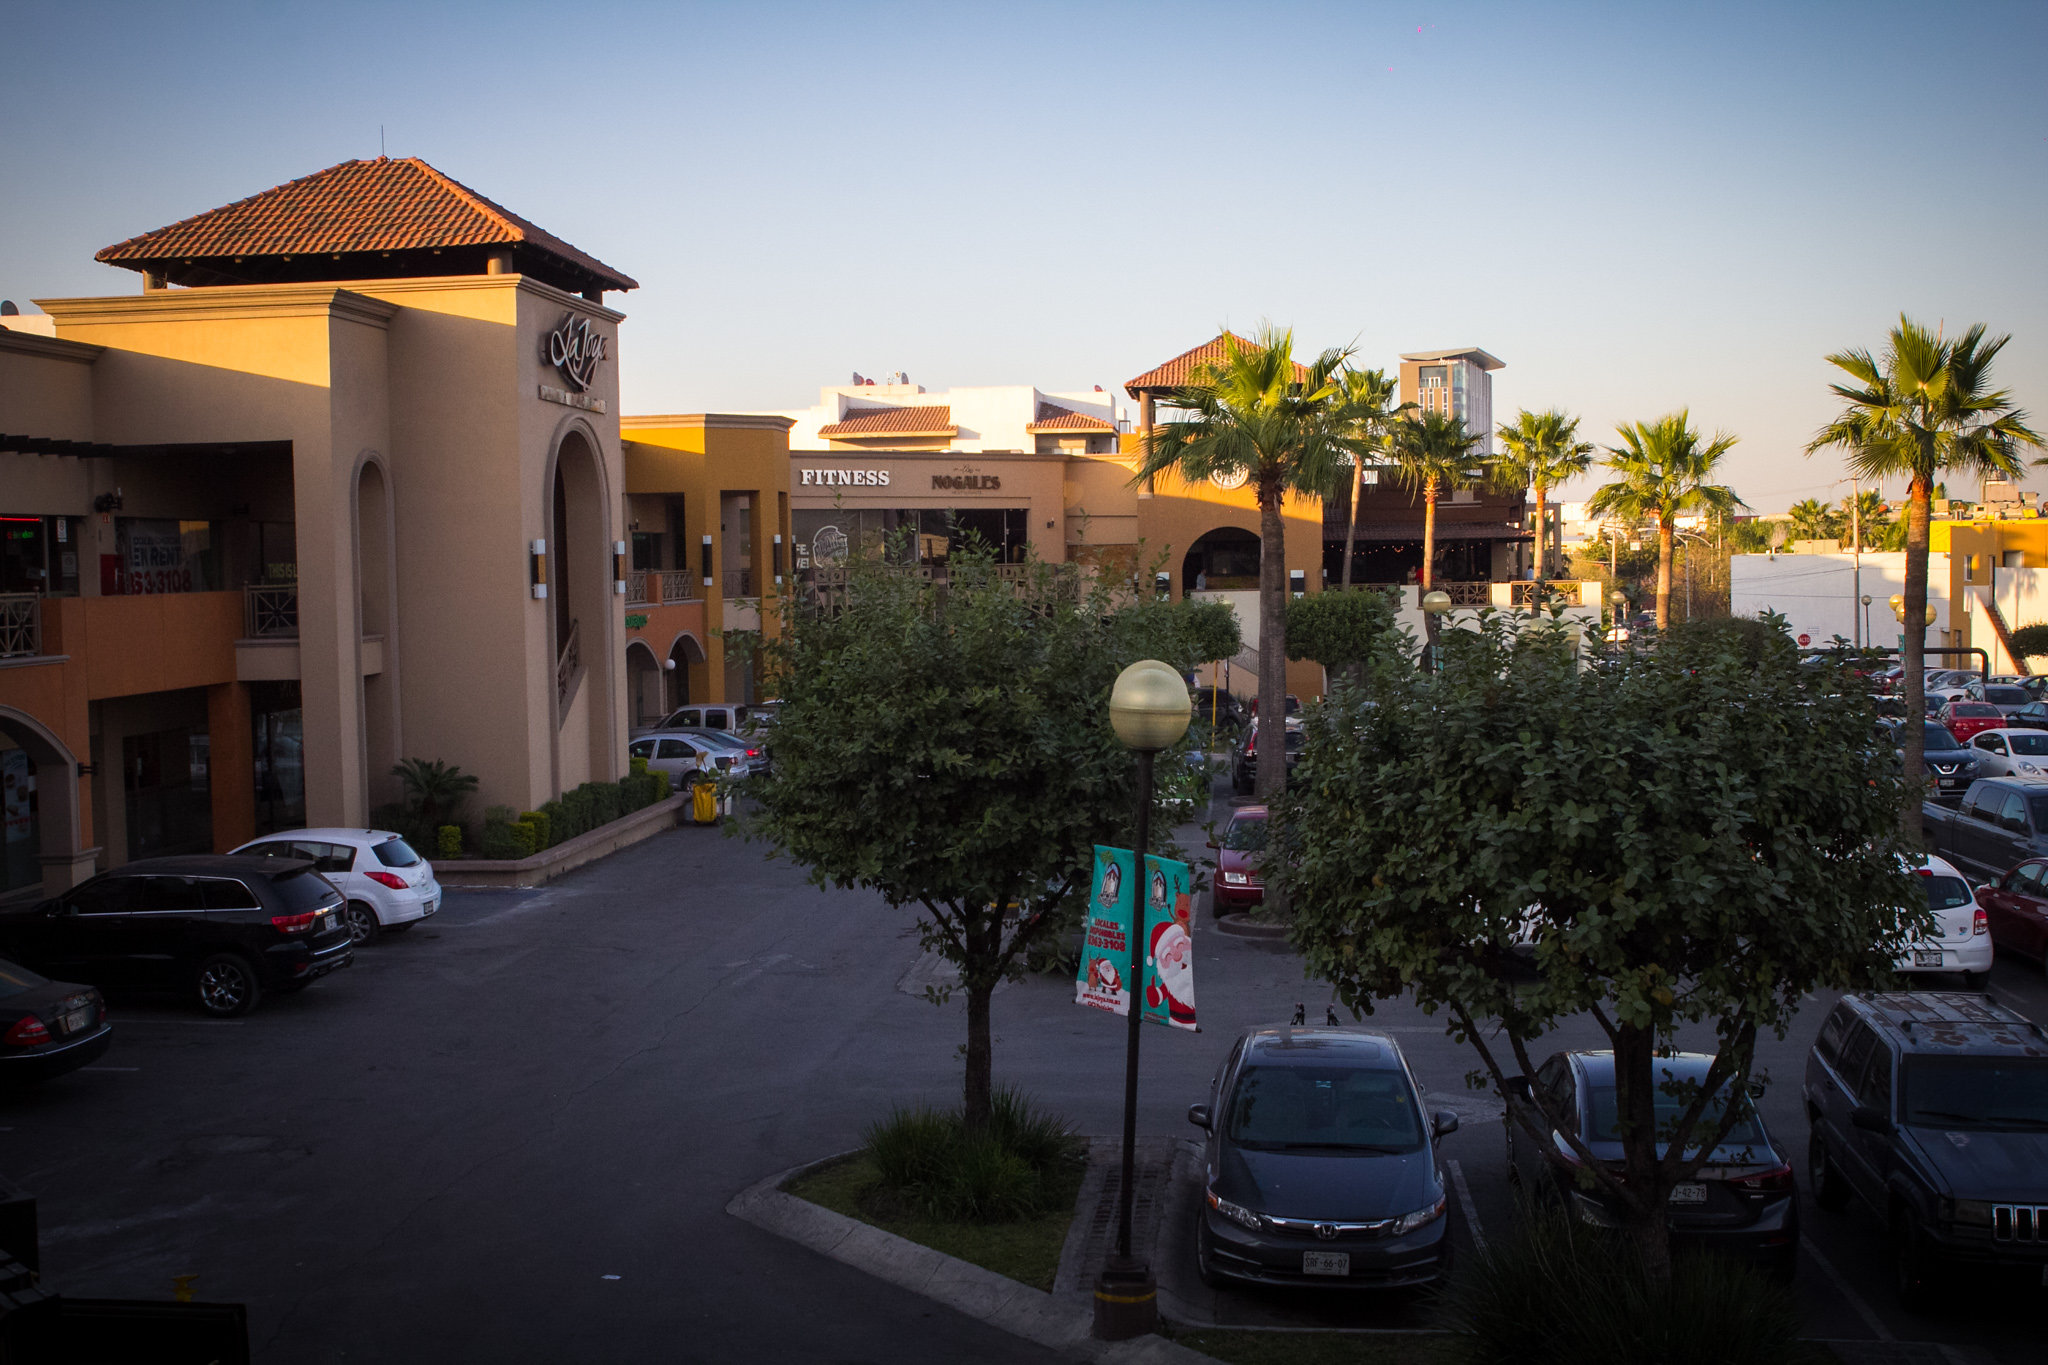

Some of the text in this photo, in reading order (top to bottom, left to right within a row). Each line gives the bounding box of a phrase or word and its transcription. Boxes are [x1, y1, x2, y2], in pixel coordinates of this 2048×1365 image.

[800, 469, 890, 486] FITNESS
[932, 475, 1000, 490] NOGALES
[1095, 918, 1119, 930] LOCALES
